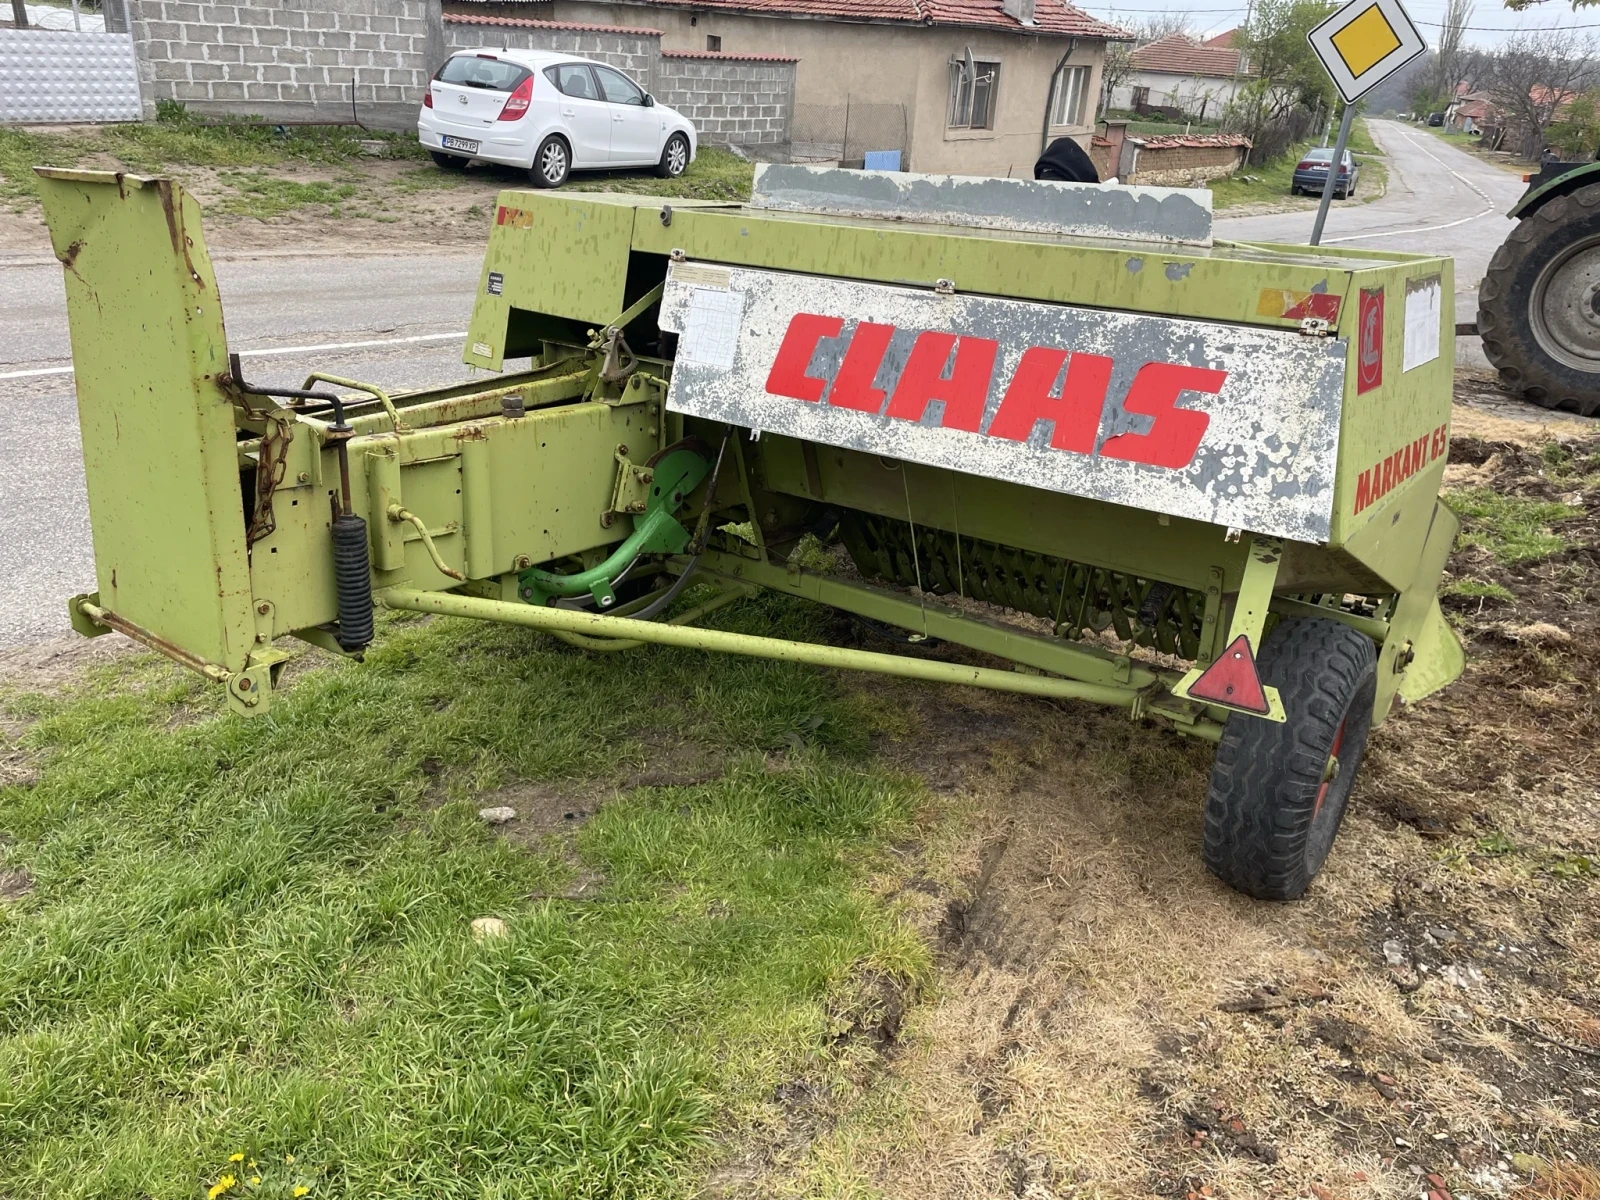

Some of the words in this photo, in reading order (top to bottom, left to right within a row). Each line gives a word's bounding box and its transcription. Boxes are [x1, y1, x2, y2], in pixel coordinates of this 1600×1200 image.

[446, 137, 454, 146] PB
[454, 139, 469, 149] 7299
[765, 312, 1229, 469] CLAAS
[1353, 432, 1430, 517] MARKANT
[1430, 423, 1447, 462] 65
